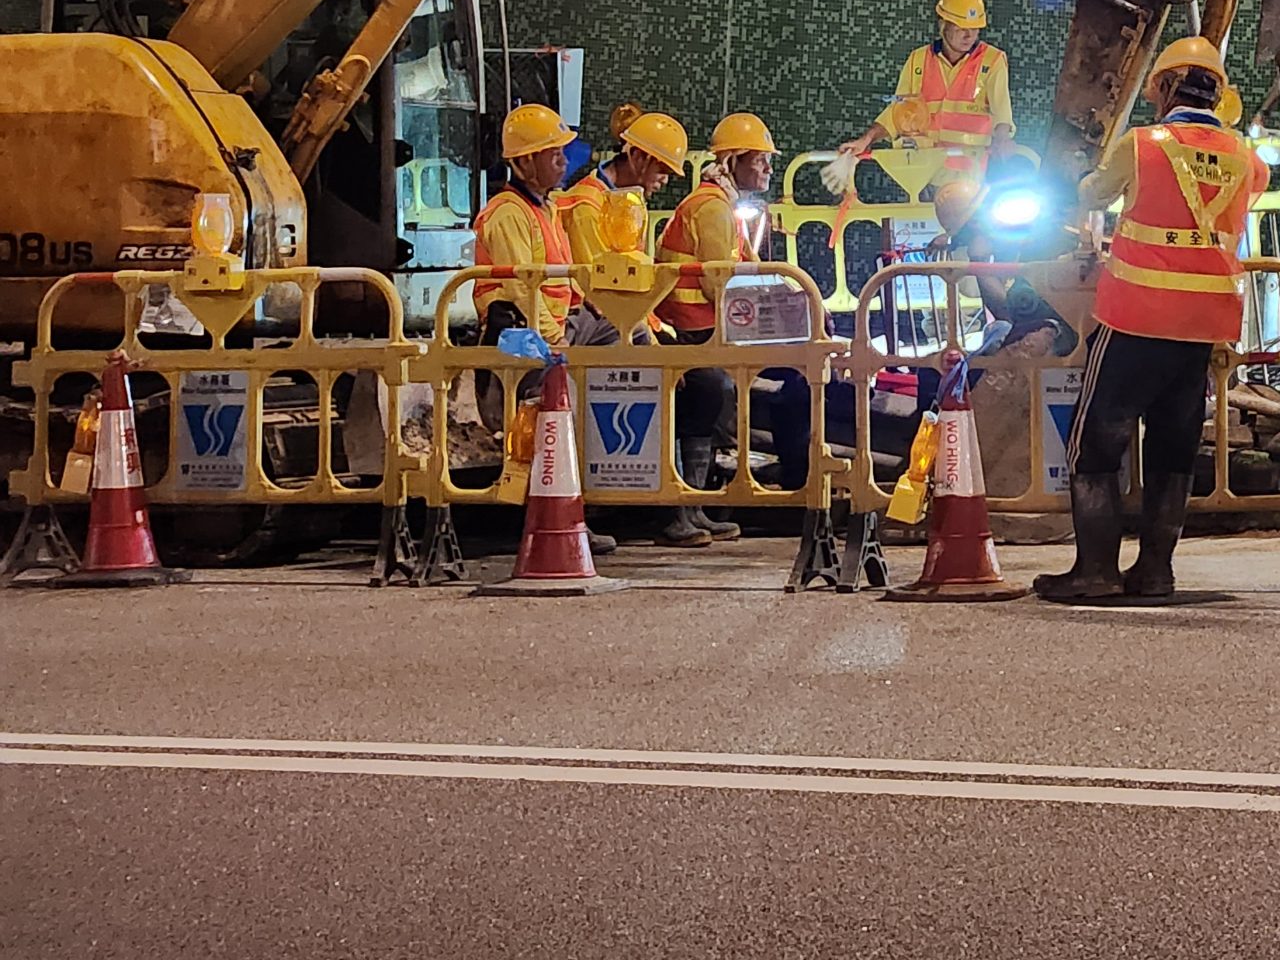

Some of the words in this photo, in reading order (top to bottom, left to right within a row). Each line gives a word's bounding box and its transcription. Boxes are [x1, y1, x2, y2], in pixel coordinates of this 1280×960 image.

[118, 245, 193, 261] REGZ
[545, 420, 557, 445] WO
[947, 420, 958, 444] WO
[541, 449, 555, 486] HING
[947, 448, 958, 482] HING
